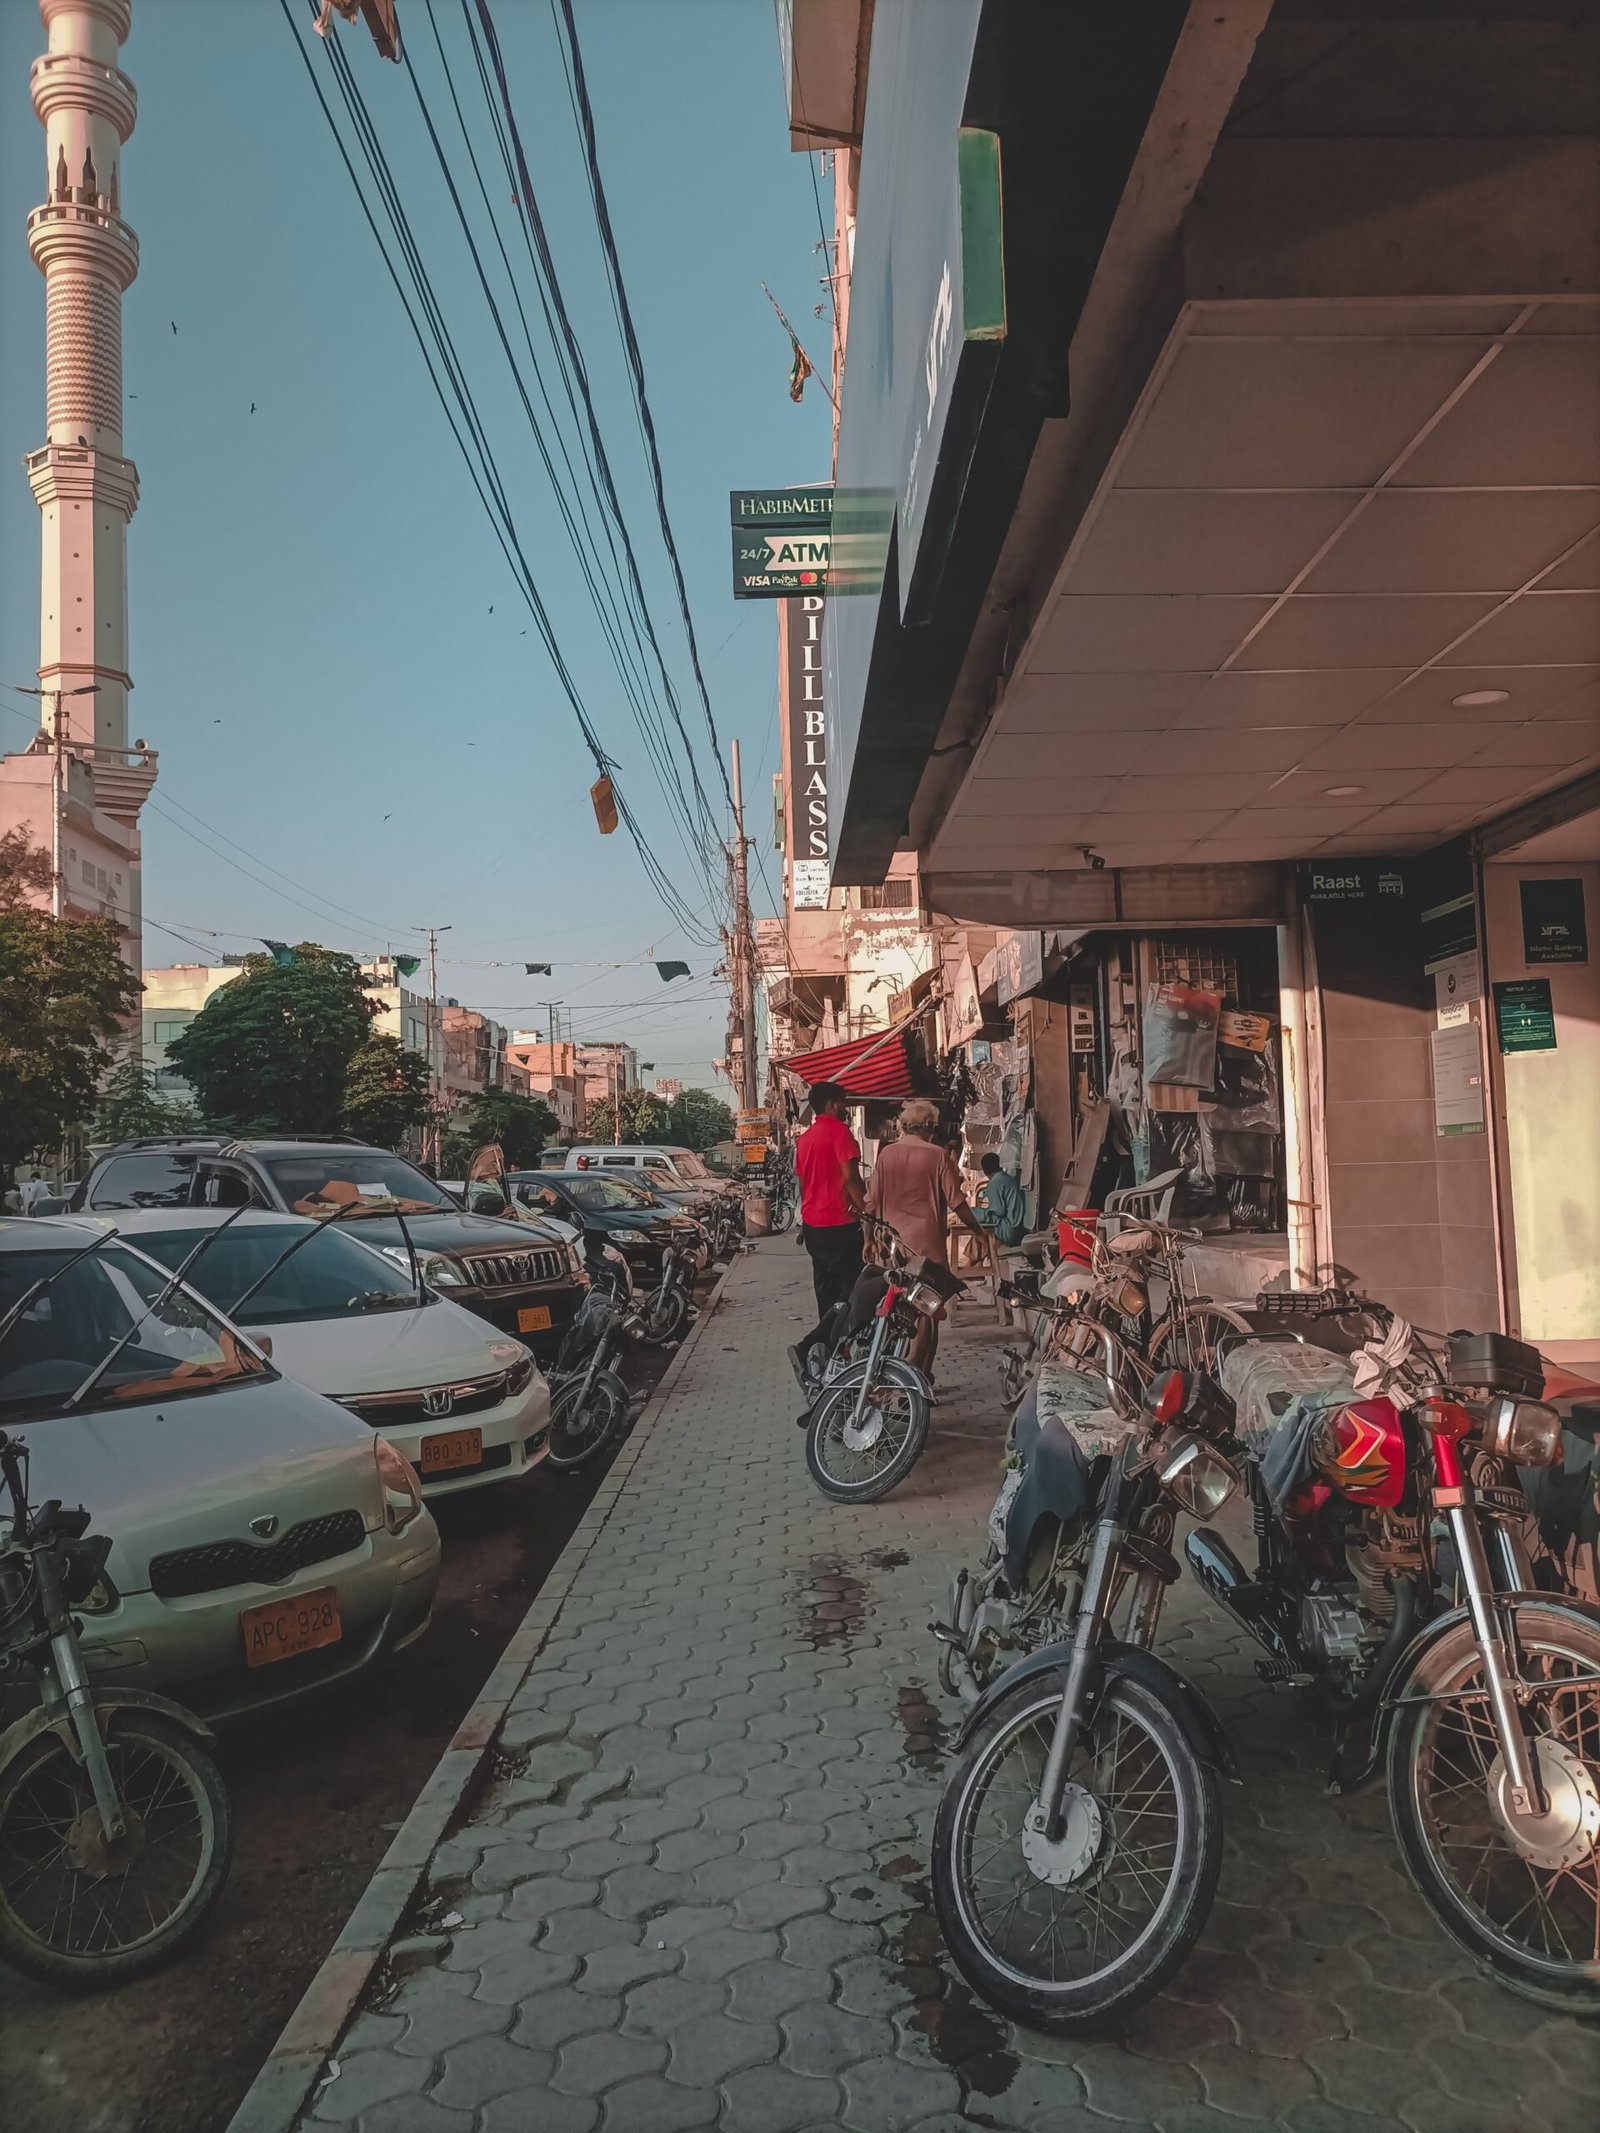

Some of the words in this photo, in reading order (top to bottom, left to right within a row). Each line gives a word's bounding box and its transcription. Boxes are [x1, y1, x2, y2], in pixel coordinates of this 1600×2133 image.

[740, 547, 770, 561] 24/7
[778, 543, 829, 563] ATM
[742, 576, 771, 587] VISA
[803, 710, 828, 856] BLASS
[1312, 875, 1361, 889] Raast
